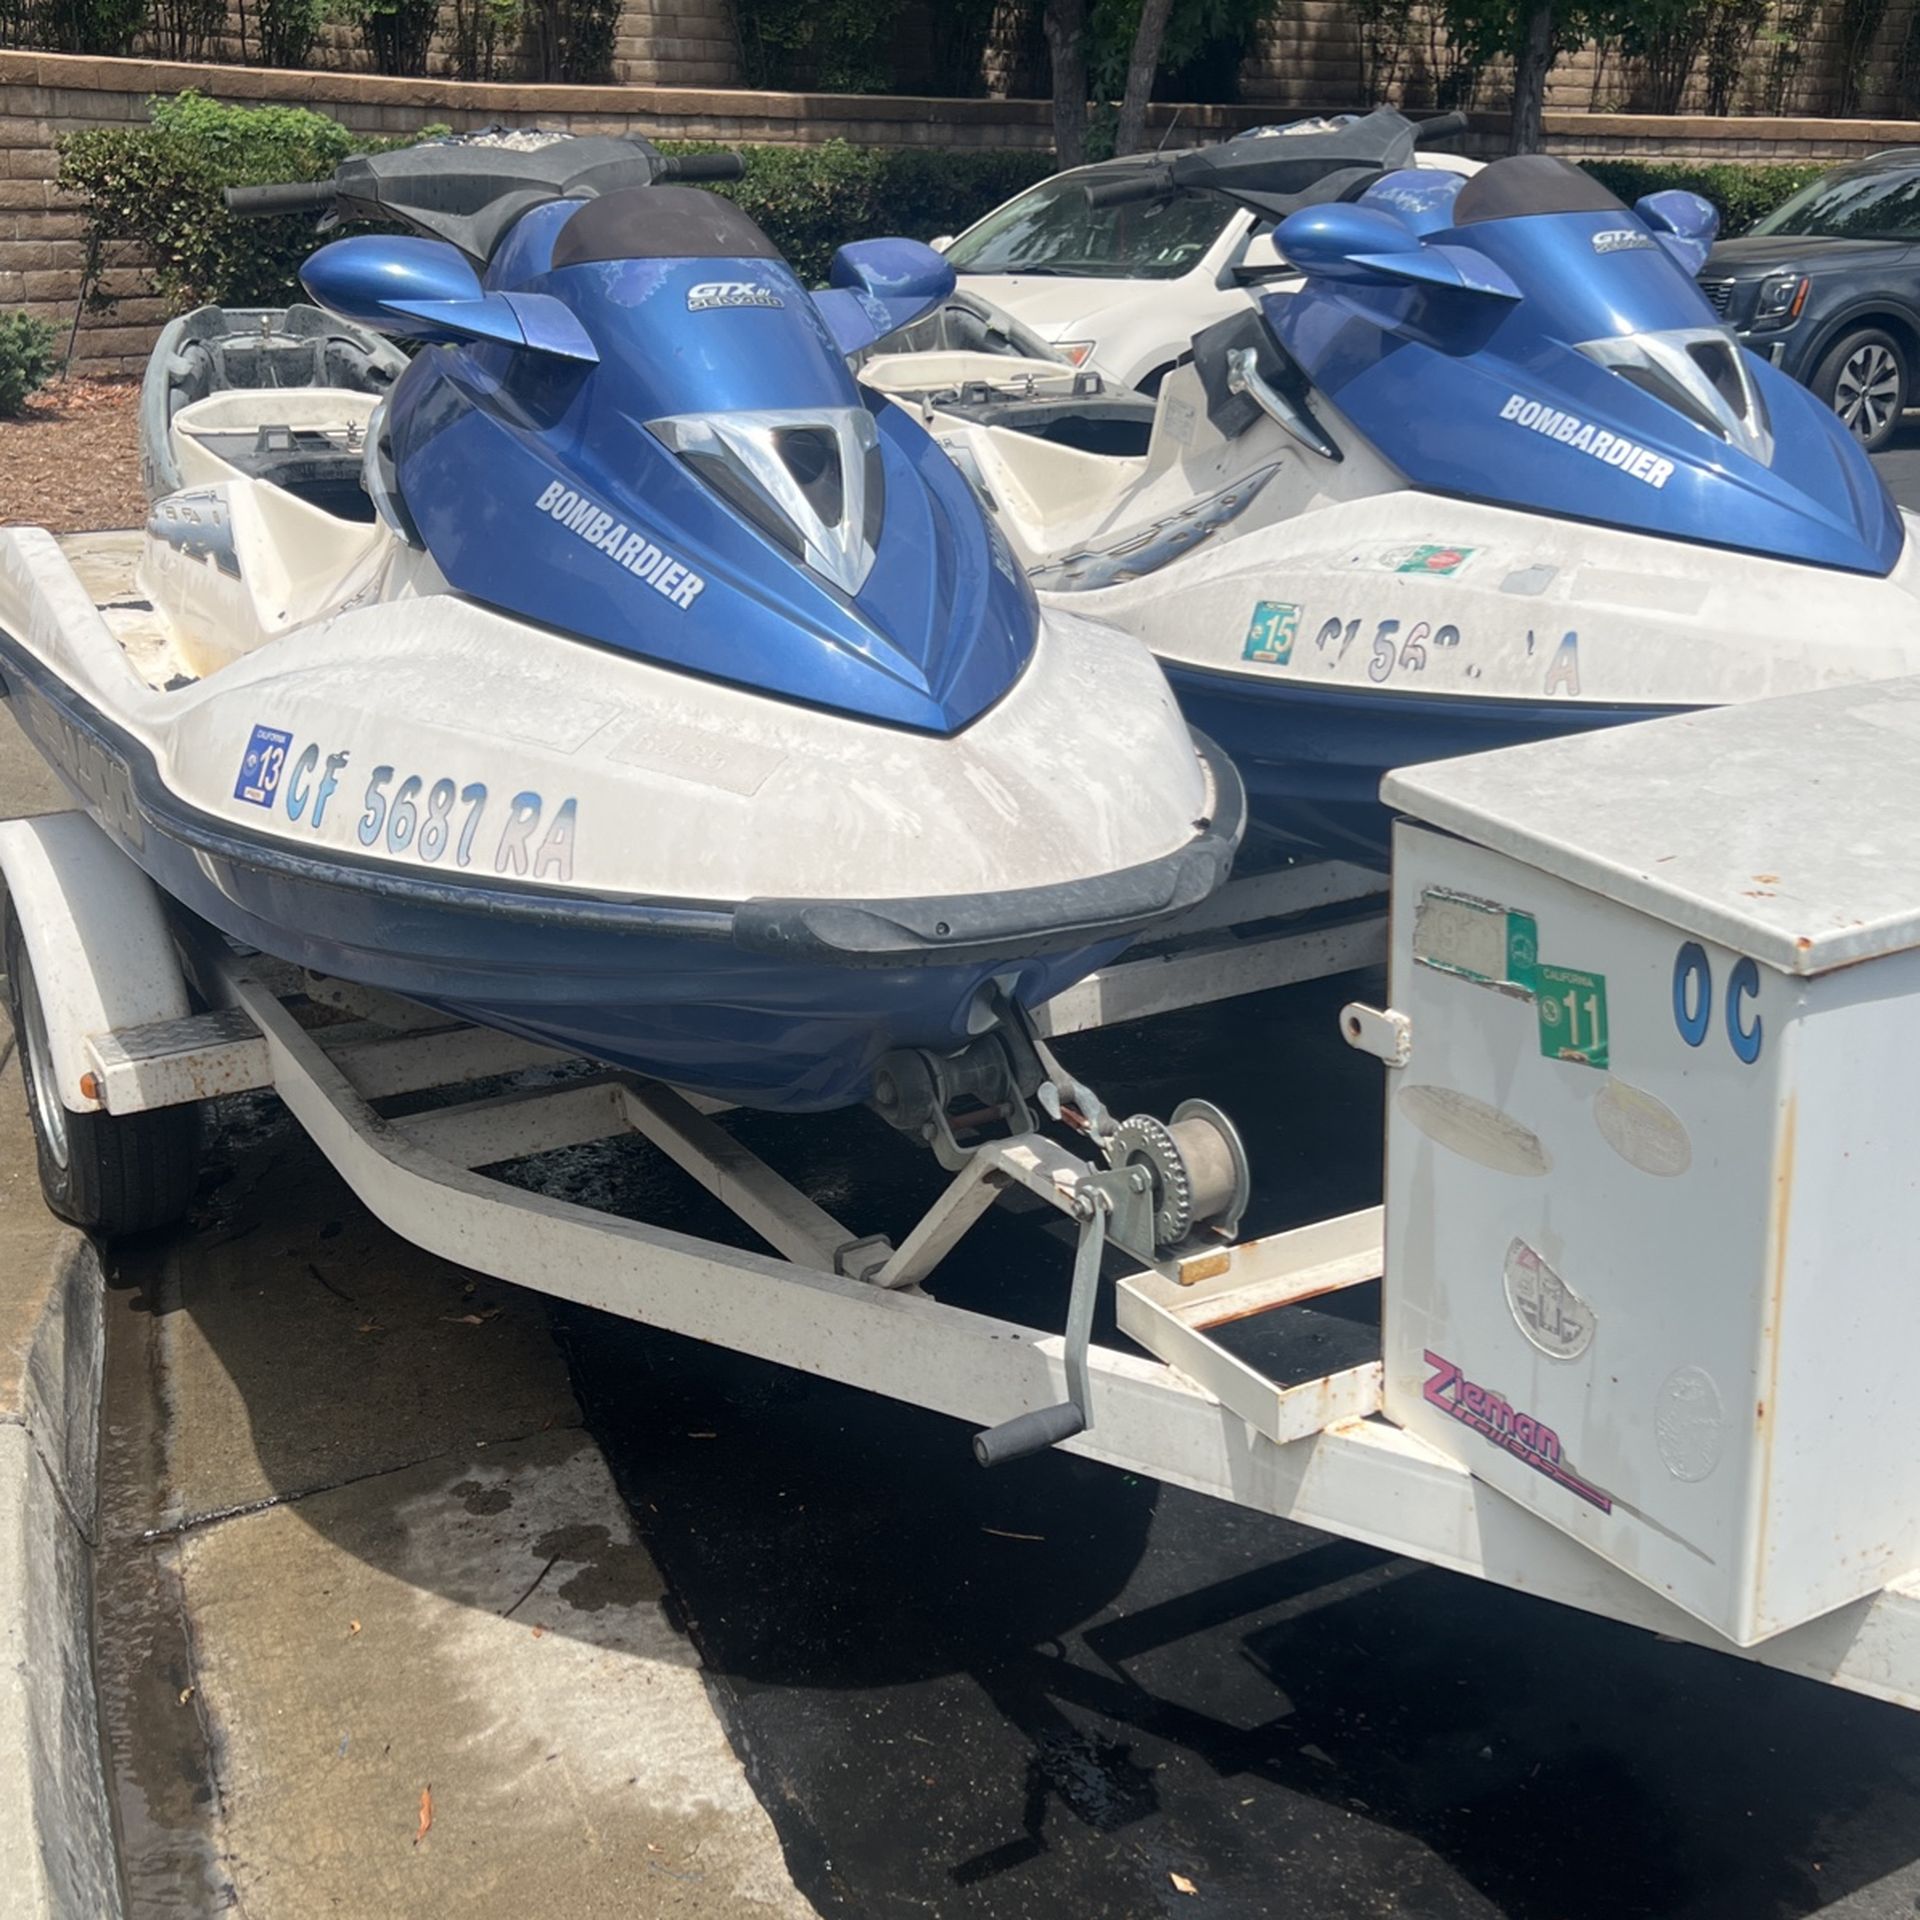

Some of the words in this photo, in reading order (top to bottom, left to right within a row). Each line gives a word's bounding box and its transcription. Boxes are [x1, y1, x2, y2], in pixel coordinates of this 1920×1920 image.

[1592, 231, 1637, 243] GTX
[689, 283, 756, 298] GTX
[1500, 394, 1675, 489] BOMBARDIER
[535, 480, 705, 610] BOMBARDIER
[1265, 614, 1298, 653] 15
[257, 745, 285, 791] 13
[286, 742, 350, 829] CF
[358, 764, 488, 868] 5687
[495, 790, 578, 882] RA
[1542, 967, 1595, 988] CALIFORNIA
[1563, 990, 1600, 1051] 11
[1423, 1348, 1561, 1466] Zieman
